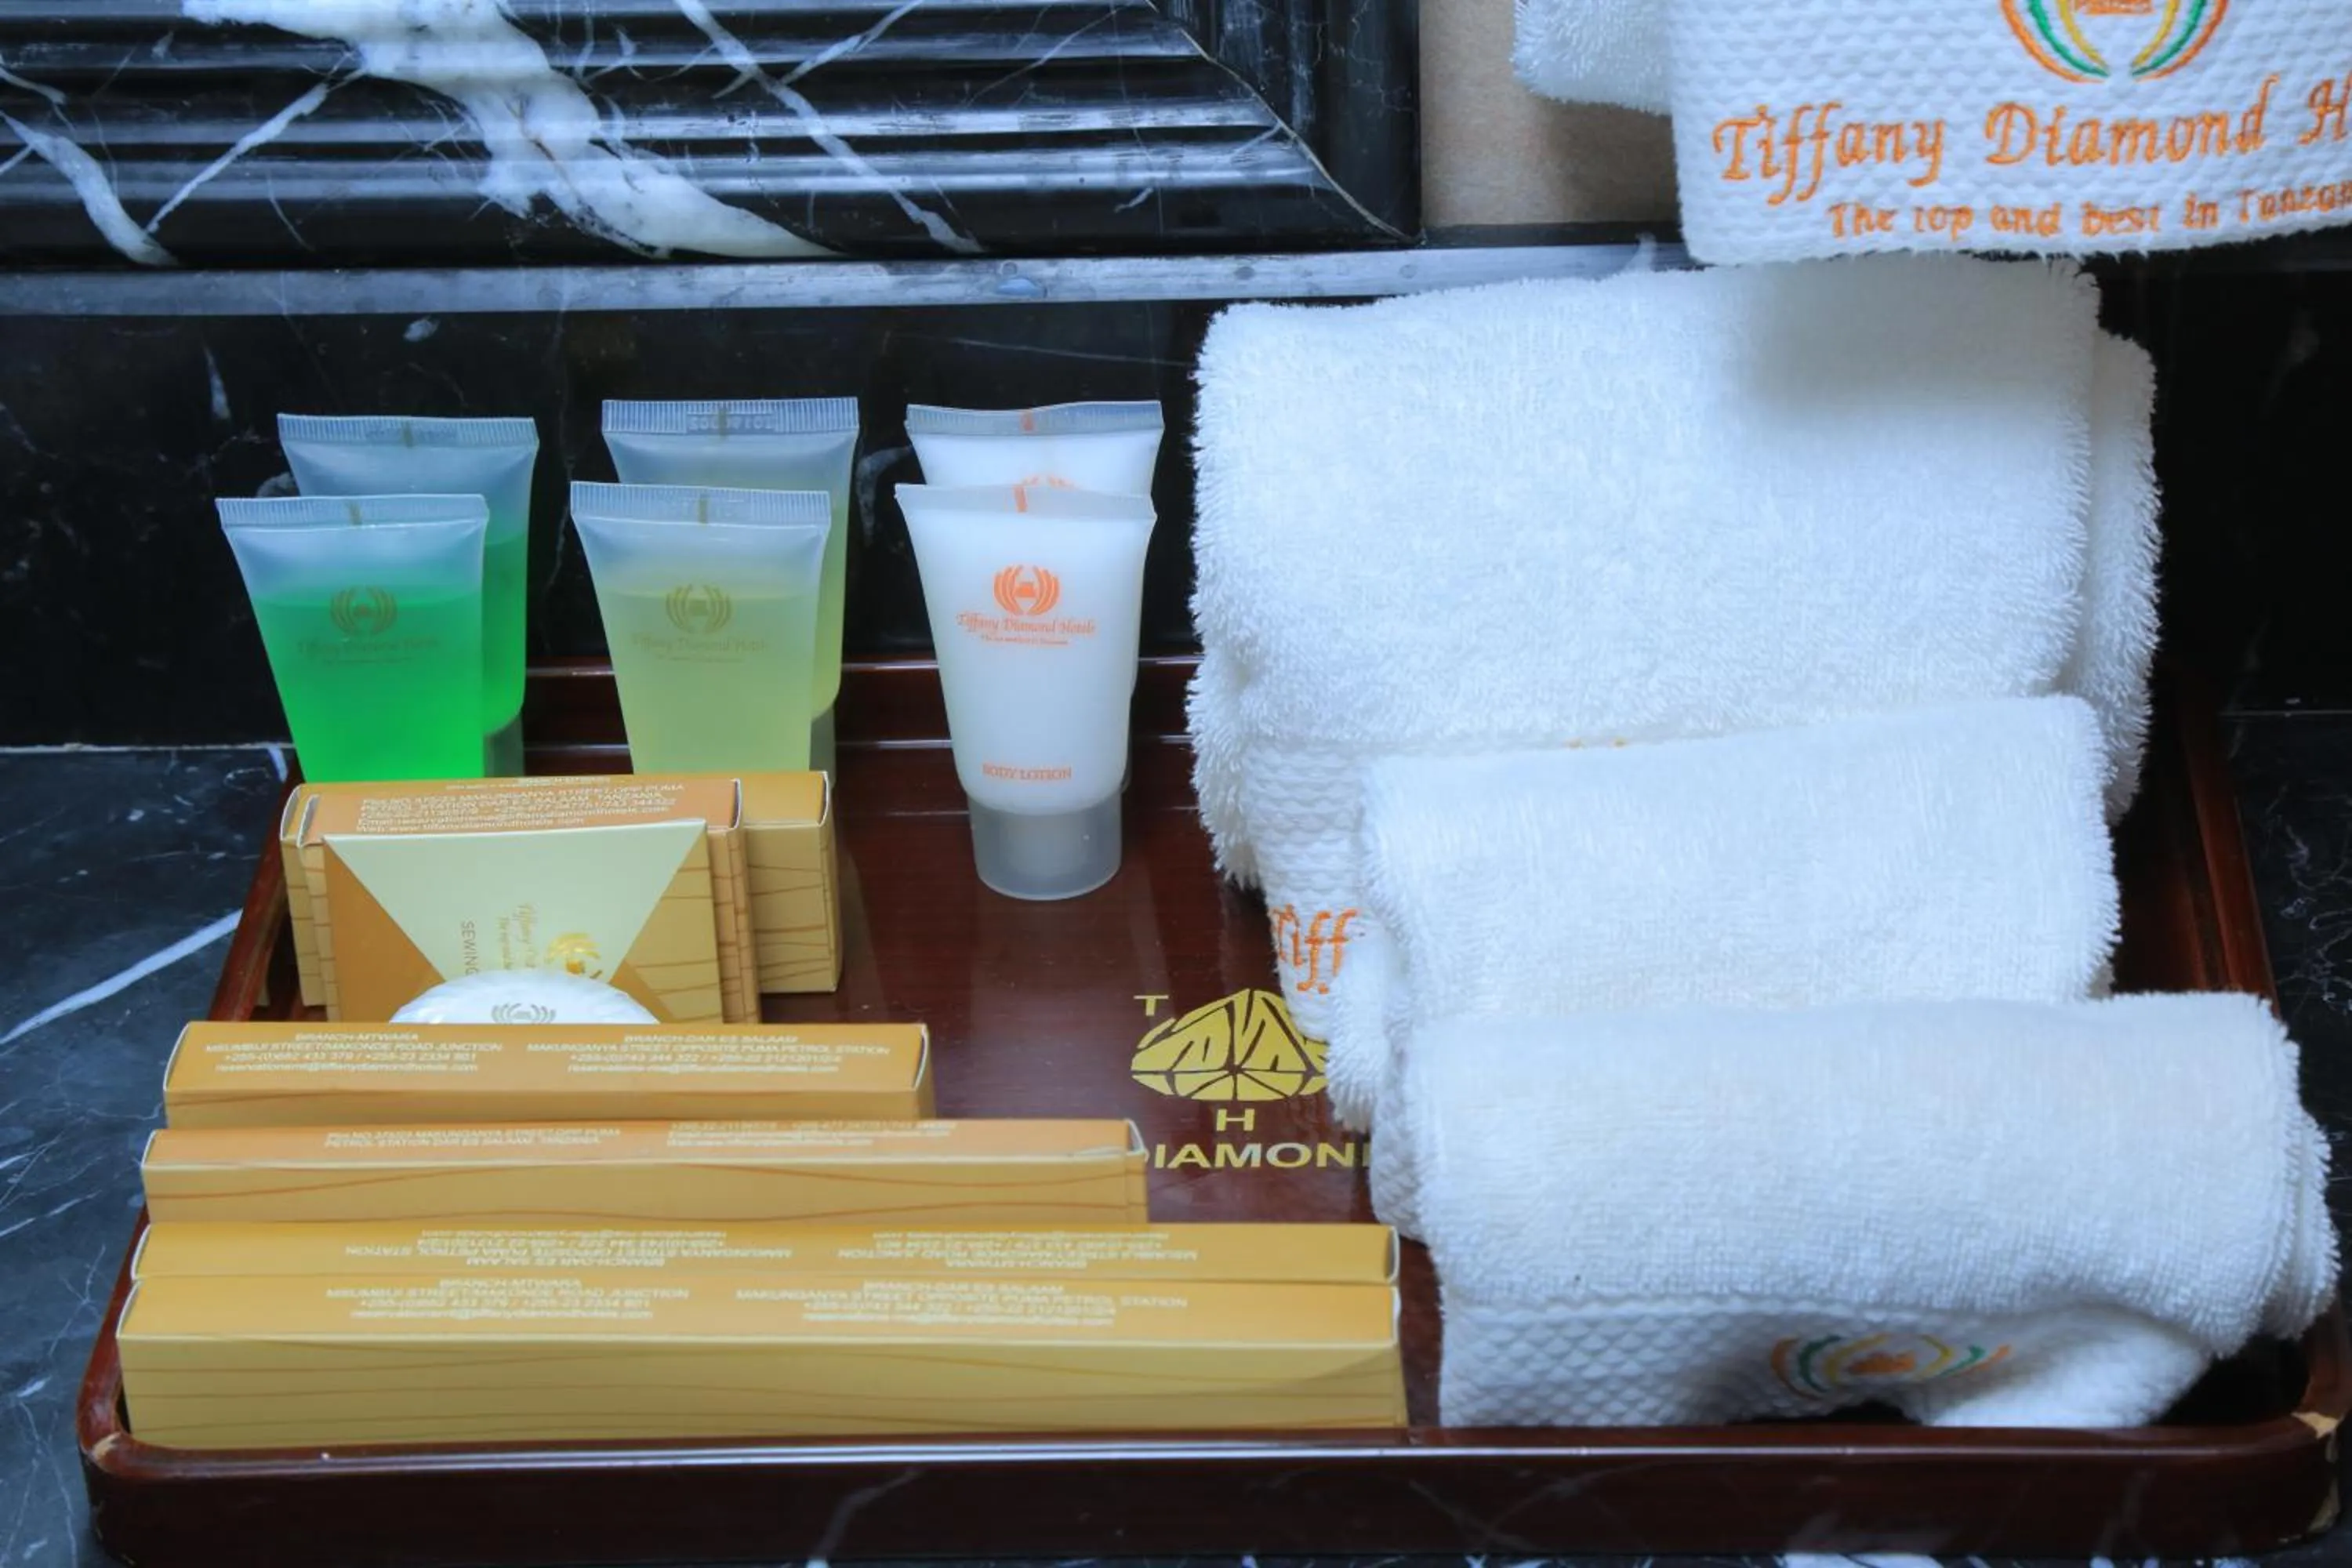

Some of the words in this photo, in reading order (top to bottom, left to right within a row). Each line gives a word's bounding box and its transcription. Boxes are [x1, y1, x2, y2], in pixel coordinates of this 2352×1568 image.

[1711, 101, 1946, 206] Tiffany
[1984, 72, 2280, 166] Diamond
[1828, 201, 1896, 238] The
[1989, 201, 2062, 237] and
[2081, 201, 2161, 237] best
[2183, 191, 2220, 229] in
[956, 612, 1000, 633] Tiffany
[1004, 618, 1056, 633] Diamond
[982, 763, 1016, 779] BODY
[1019, 768, 1073, 780] LOTION
[1271, 903, 1359, 996] Tiff
[1134, 994, 1170, 1017] T
[1215, 1108, 1255, 1132] H
[1154, 1142, 1370, 1170] IAMON
